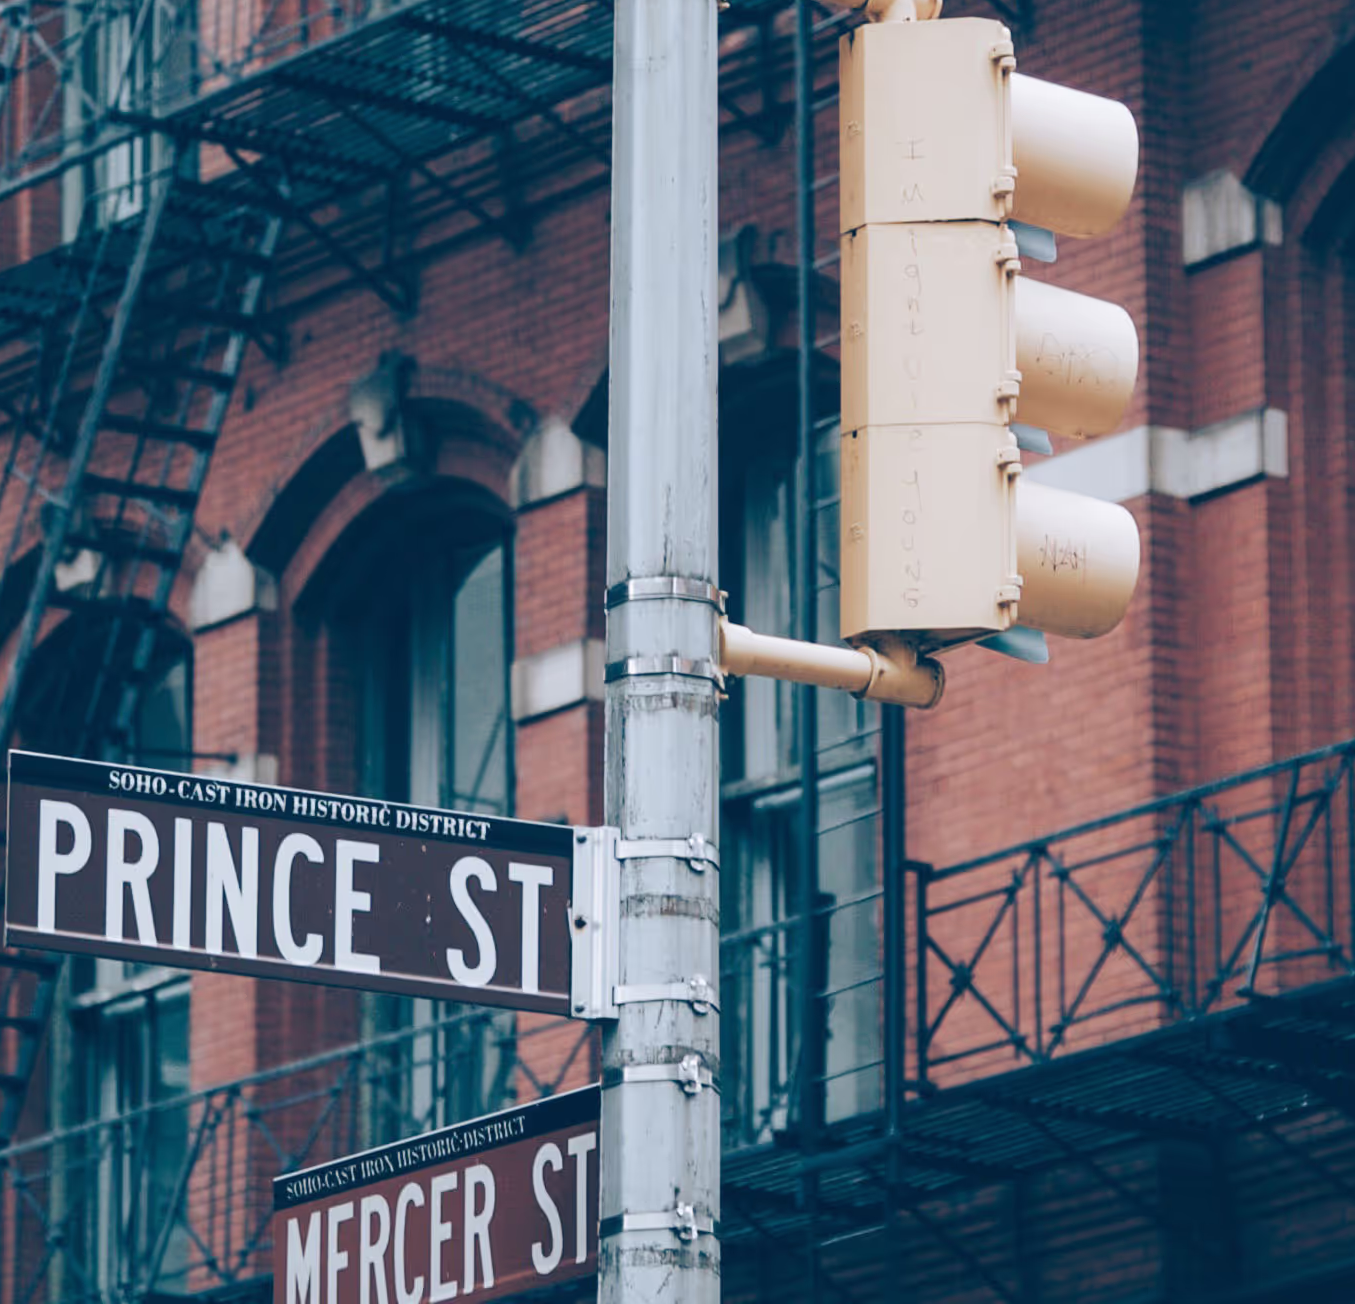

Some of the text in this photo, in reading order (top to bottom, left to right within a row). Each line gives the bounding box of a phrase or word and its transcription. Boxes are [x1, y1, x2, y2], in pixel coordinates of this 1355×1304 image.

[108, 770, 491, 841] SOHO-CAST IRON HISTORIC DISTRICT
[37, 799, 554, 994] PRINCE ST
[360, 1154, 395, 1180] IRON
[463, 1115, 526, 1151] DISTRICT
[286, 1131, 597, 1304] MERCER ST
